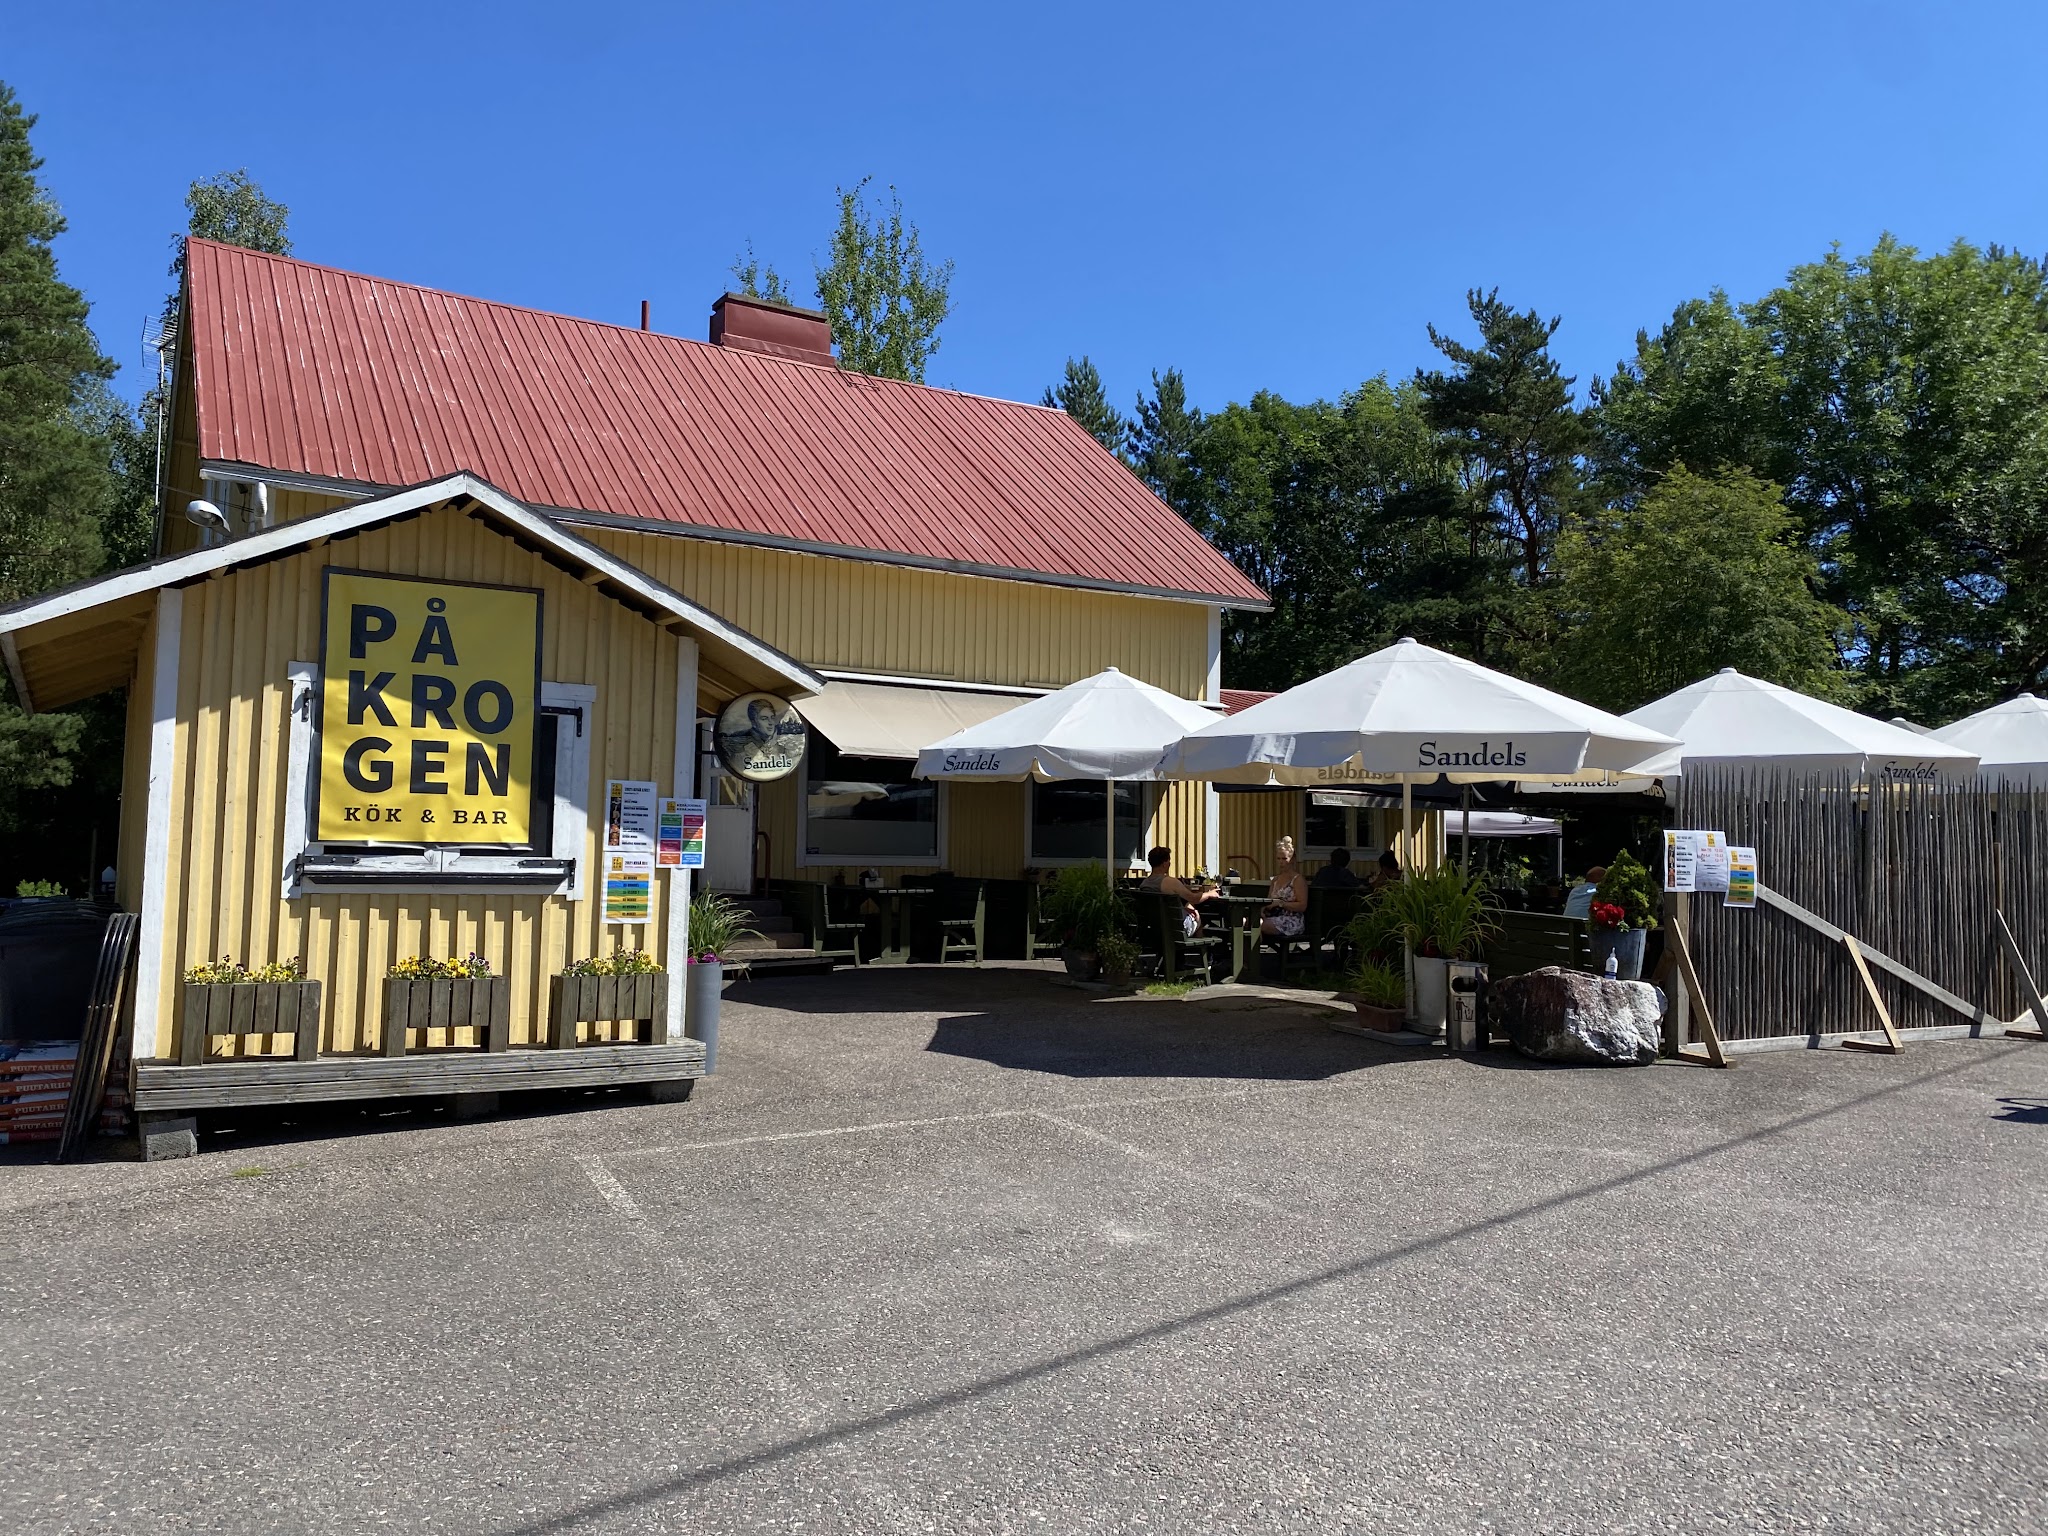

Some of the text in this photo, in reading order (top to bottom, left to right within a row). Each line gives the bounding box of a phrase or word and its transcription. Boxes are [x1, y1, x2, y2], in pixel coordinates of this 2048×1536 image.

[350, 597, 459, 666] PÅ
[347, 669, 514, 735] KRO
[343, 736, 511, 797] GEN
[743, 755, 793, 770] Sandels
[942, 753, 1001, 772] Sandels
[1418, 741, 1527, 768] Sandels
[344, 804, 508, 825] KÖK & BAR
